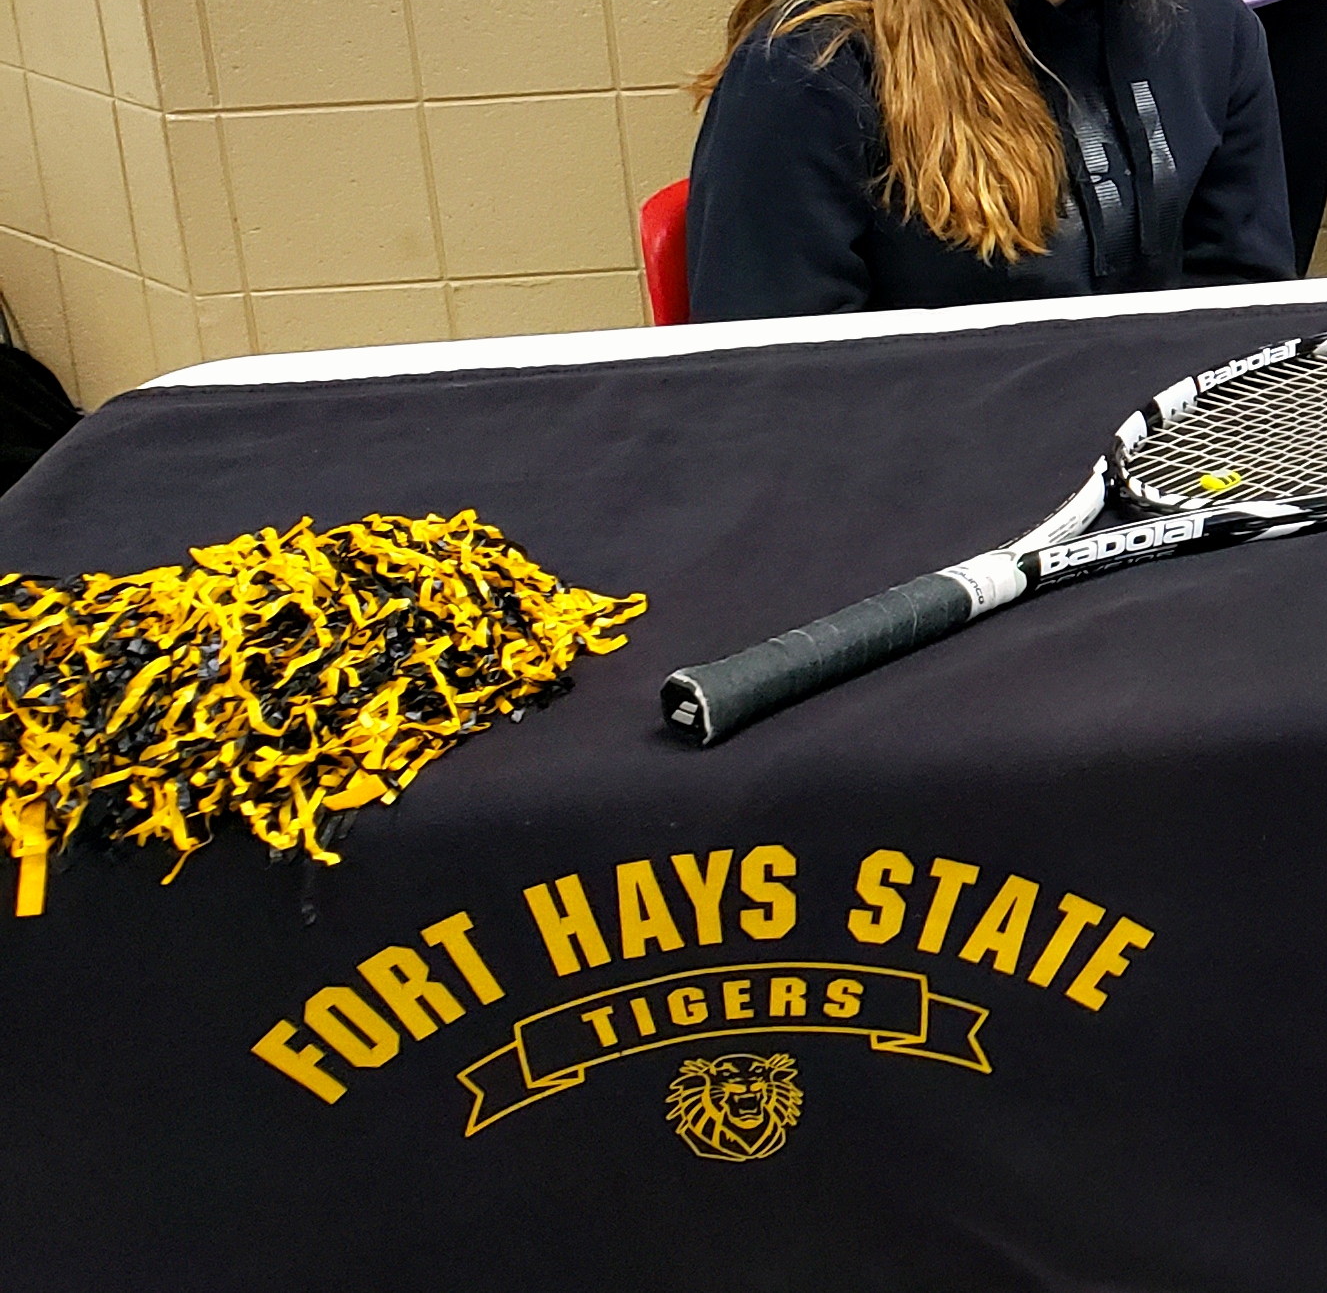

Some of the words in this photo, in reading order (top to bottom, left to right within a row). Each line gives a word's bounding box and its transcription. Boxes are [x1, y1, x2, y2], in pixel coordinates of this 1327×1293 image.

[1197, 338, 1302, 393] Babolat
[1038, 510, 1212, 577] Babolat
[250, 910, 506, 1105] FORT
[523, 844, 798, 978] HAYS
[847, 848, 1157, 1013] STATE
[579, 975, 866, 1049] TIGERS
